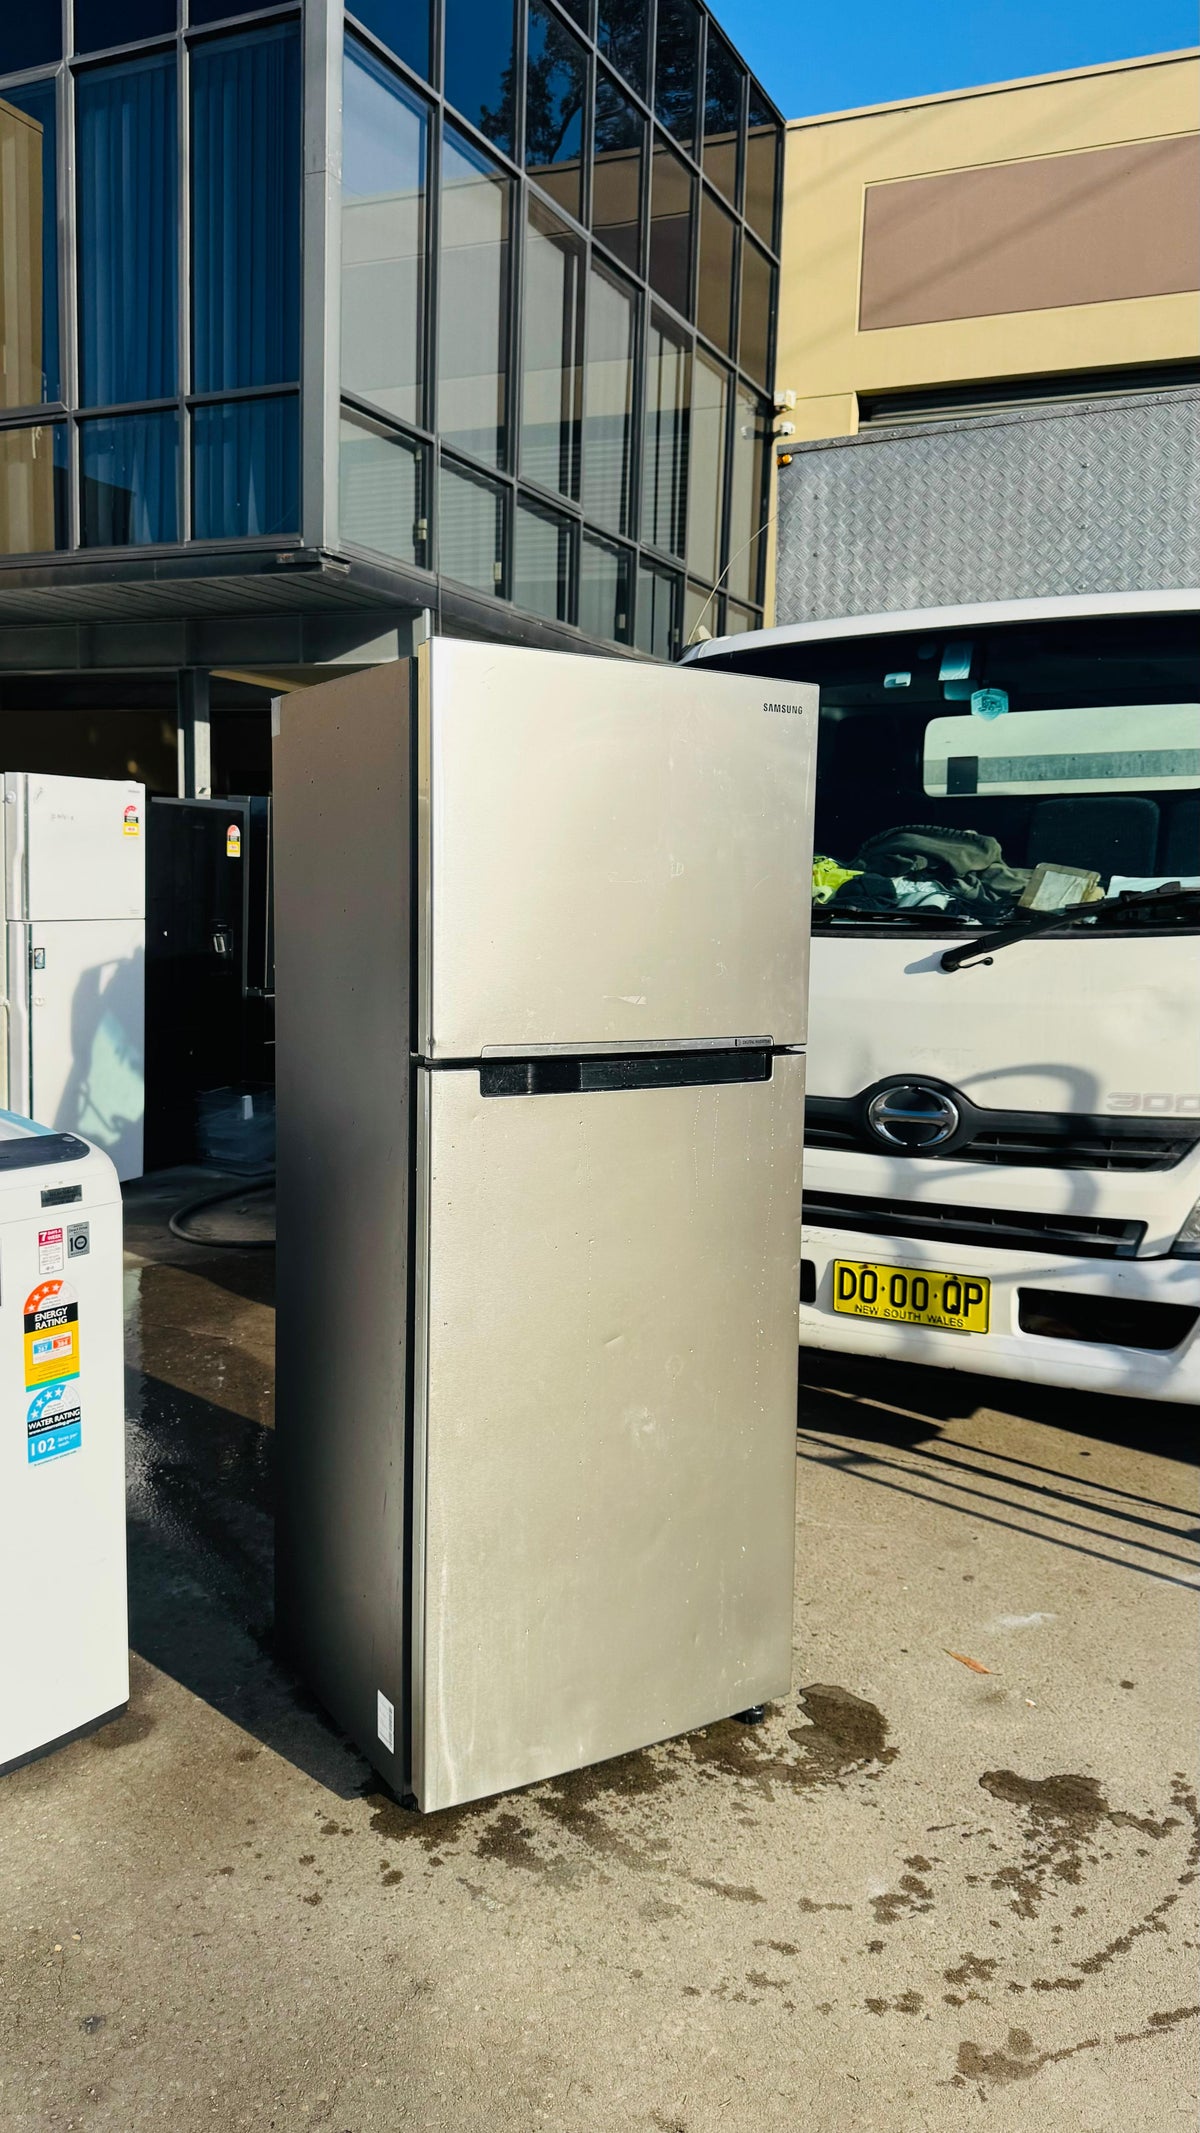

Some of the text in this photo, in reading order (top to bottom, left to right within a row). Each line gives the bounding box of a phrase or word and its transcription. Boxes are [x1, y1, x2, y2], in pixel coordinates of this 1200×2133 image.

[763, 702, 803, 715] SAMSUNG
[1106, 1091, 1200, 1113] 300
[39, 1231, 47, 1242] 7
[70, 1235, 88, 1251] 10
[34, 1306, 68, 1322] ENERGY
[855, 1303, 964, 1328] NEW SOUTH WALES
[35, 1315, 68, 1330] RATING
[28, 1417, 54, 1430] WATER
[54, 1409, 80, 1422] RATING
[31, 1437, 56, 1456] 102
